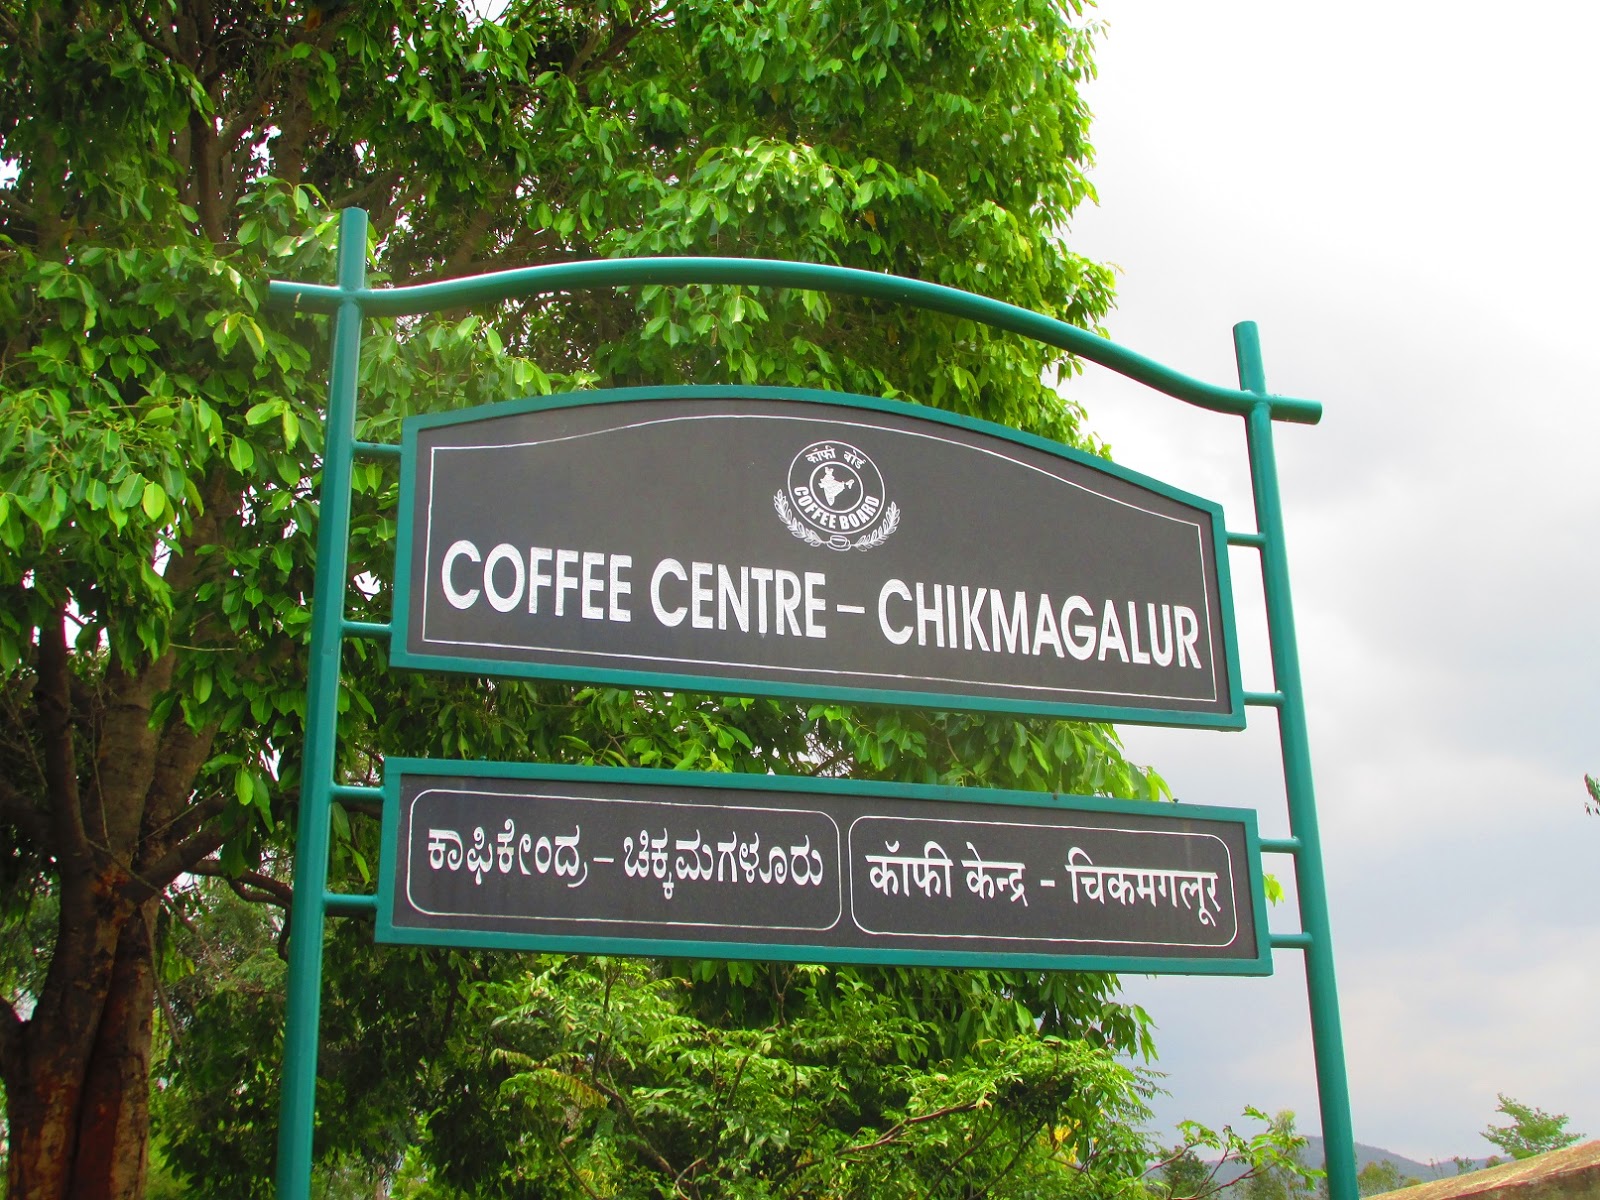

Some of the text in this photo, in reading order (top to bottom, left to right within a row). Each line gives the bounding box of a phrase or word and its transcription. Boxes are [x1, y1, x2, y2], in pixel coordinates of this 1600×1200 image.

[794, 486, 880, 530] COFFEE BOARD
[441, 539, 633, 623] COFFEE
[650, 557, 828, 640] CENTRE
[877, 578, 1202, 671] CHIKMAGALUR
[623, 827, 824, 900] ಚಿಕ್ಕಮಗಳೂರು
[864, 840, 954, 898] कॉफी
[960, 841, 1029, 907] केन्द्र
[1064, 846, 1222, 927] चिकमगलूर
